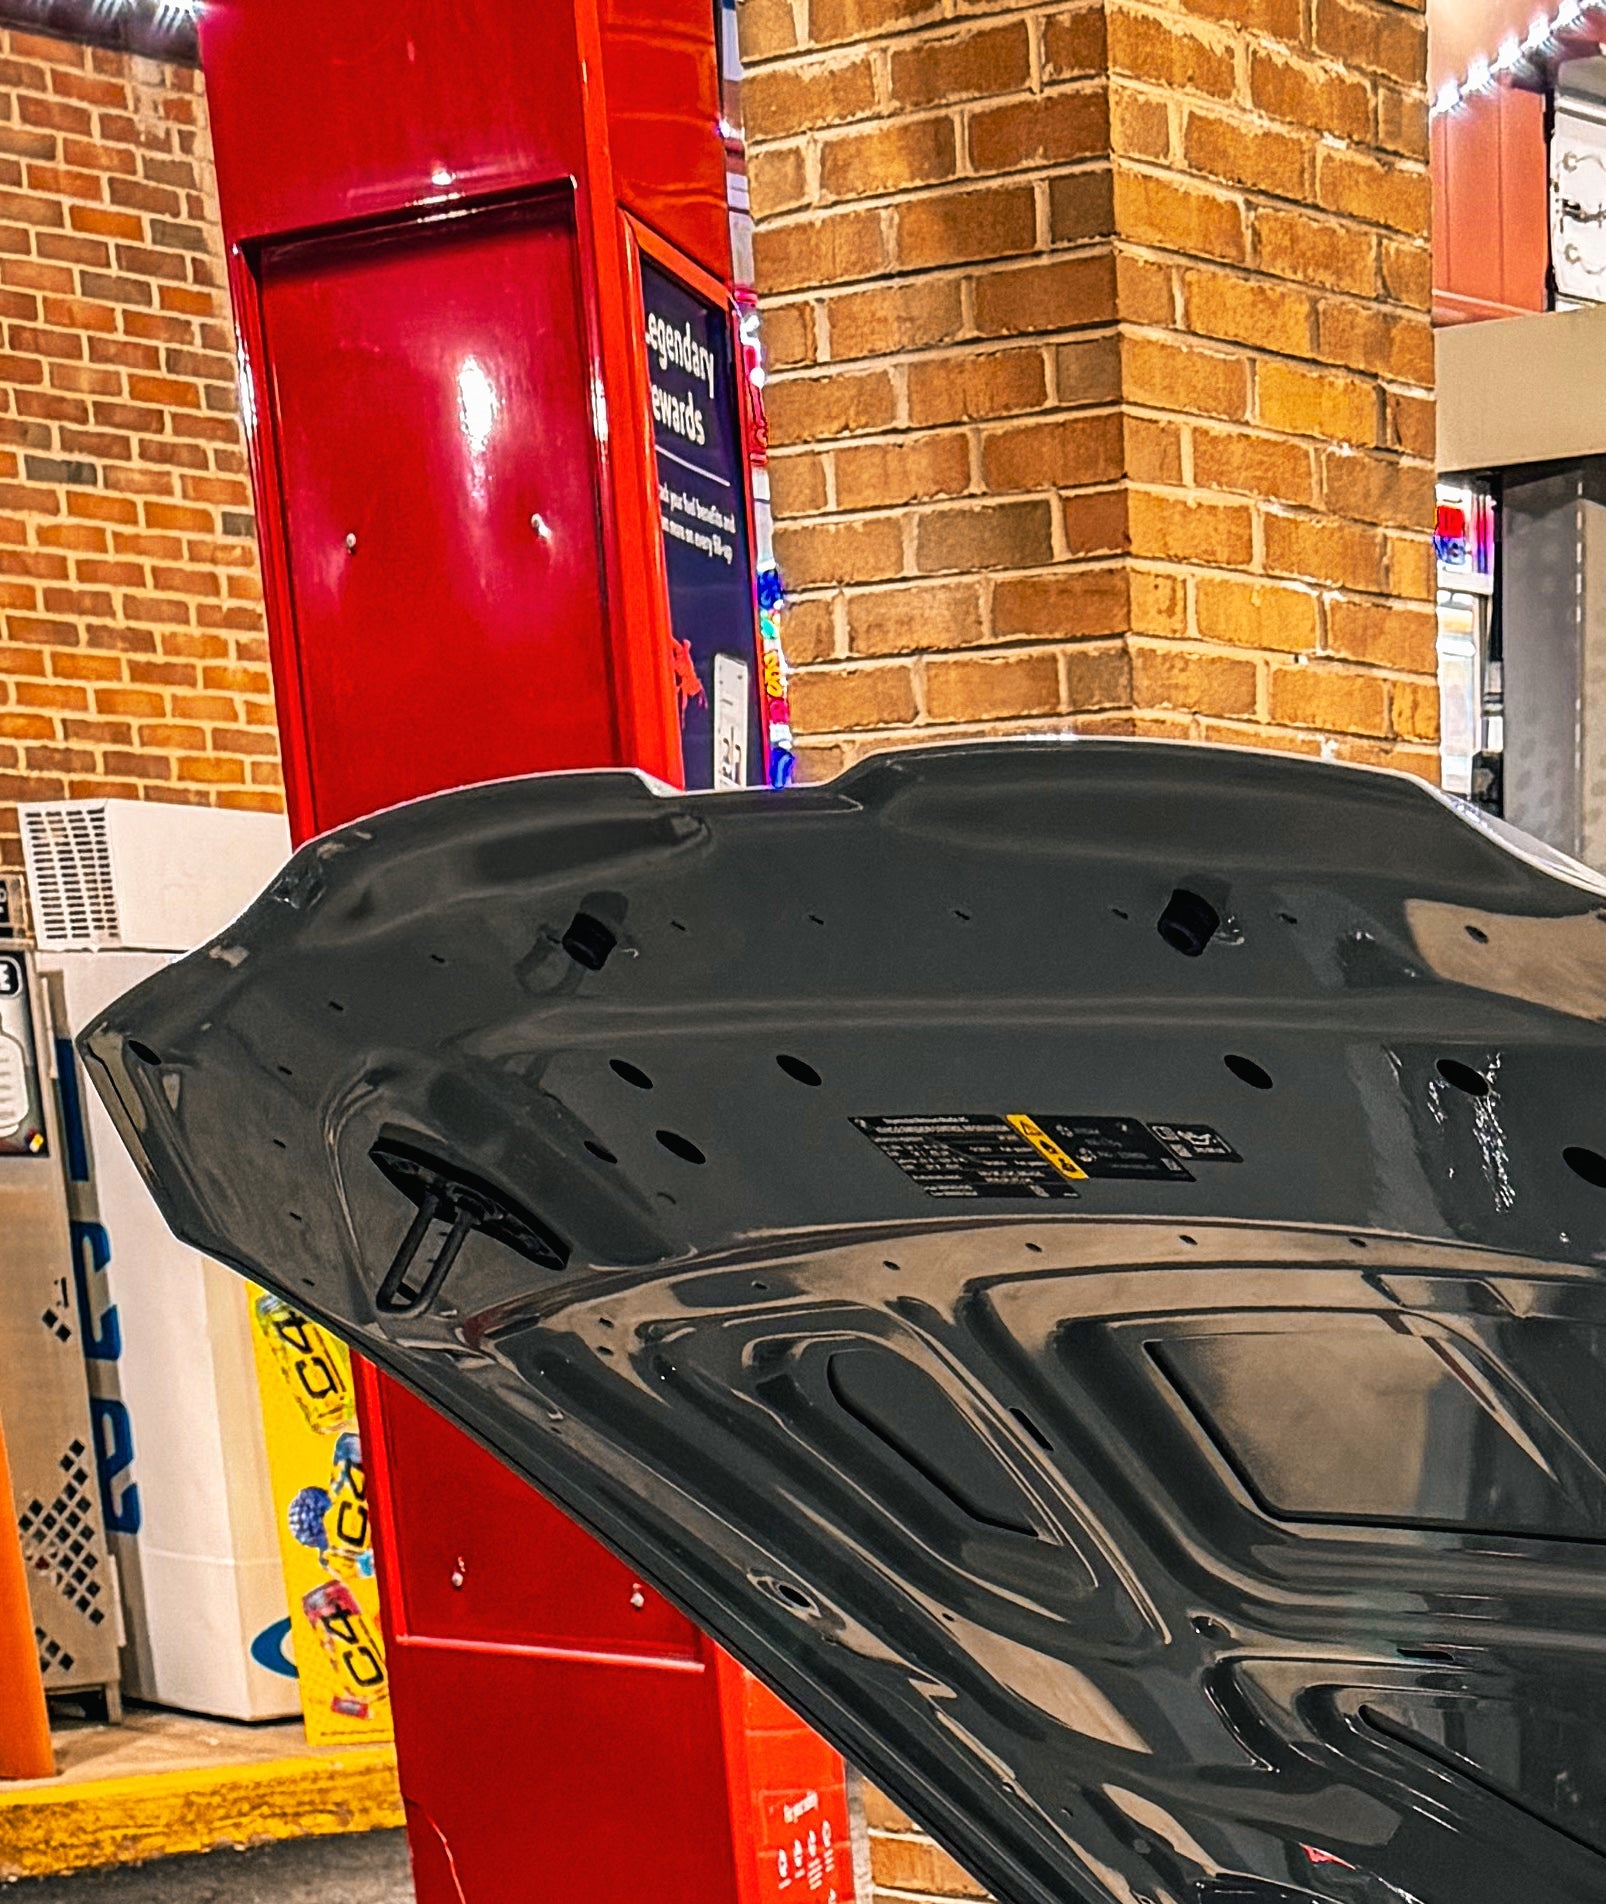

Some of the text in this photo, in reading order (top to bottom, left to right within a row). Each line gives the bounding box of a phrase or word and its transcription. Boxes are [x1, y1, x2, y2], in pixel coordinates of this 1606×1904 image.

[645, 310, 715, 399] egendary
[651, 382, 705, 445] ewards
[275, 1311, 339, 1399] C4
[321, 1607, 385, 1688] C4
